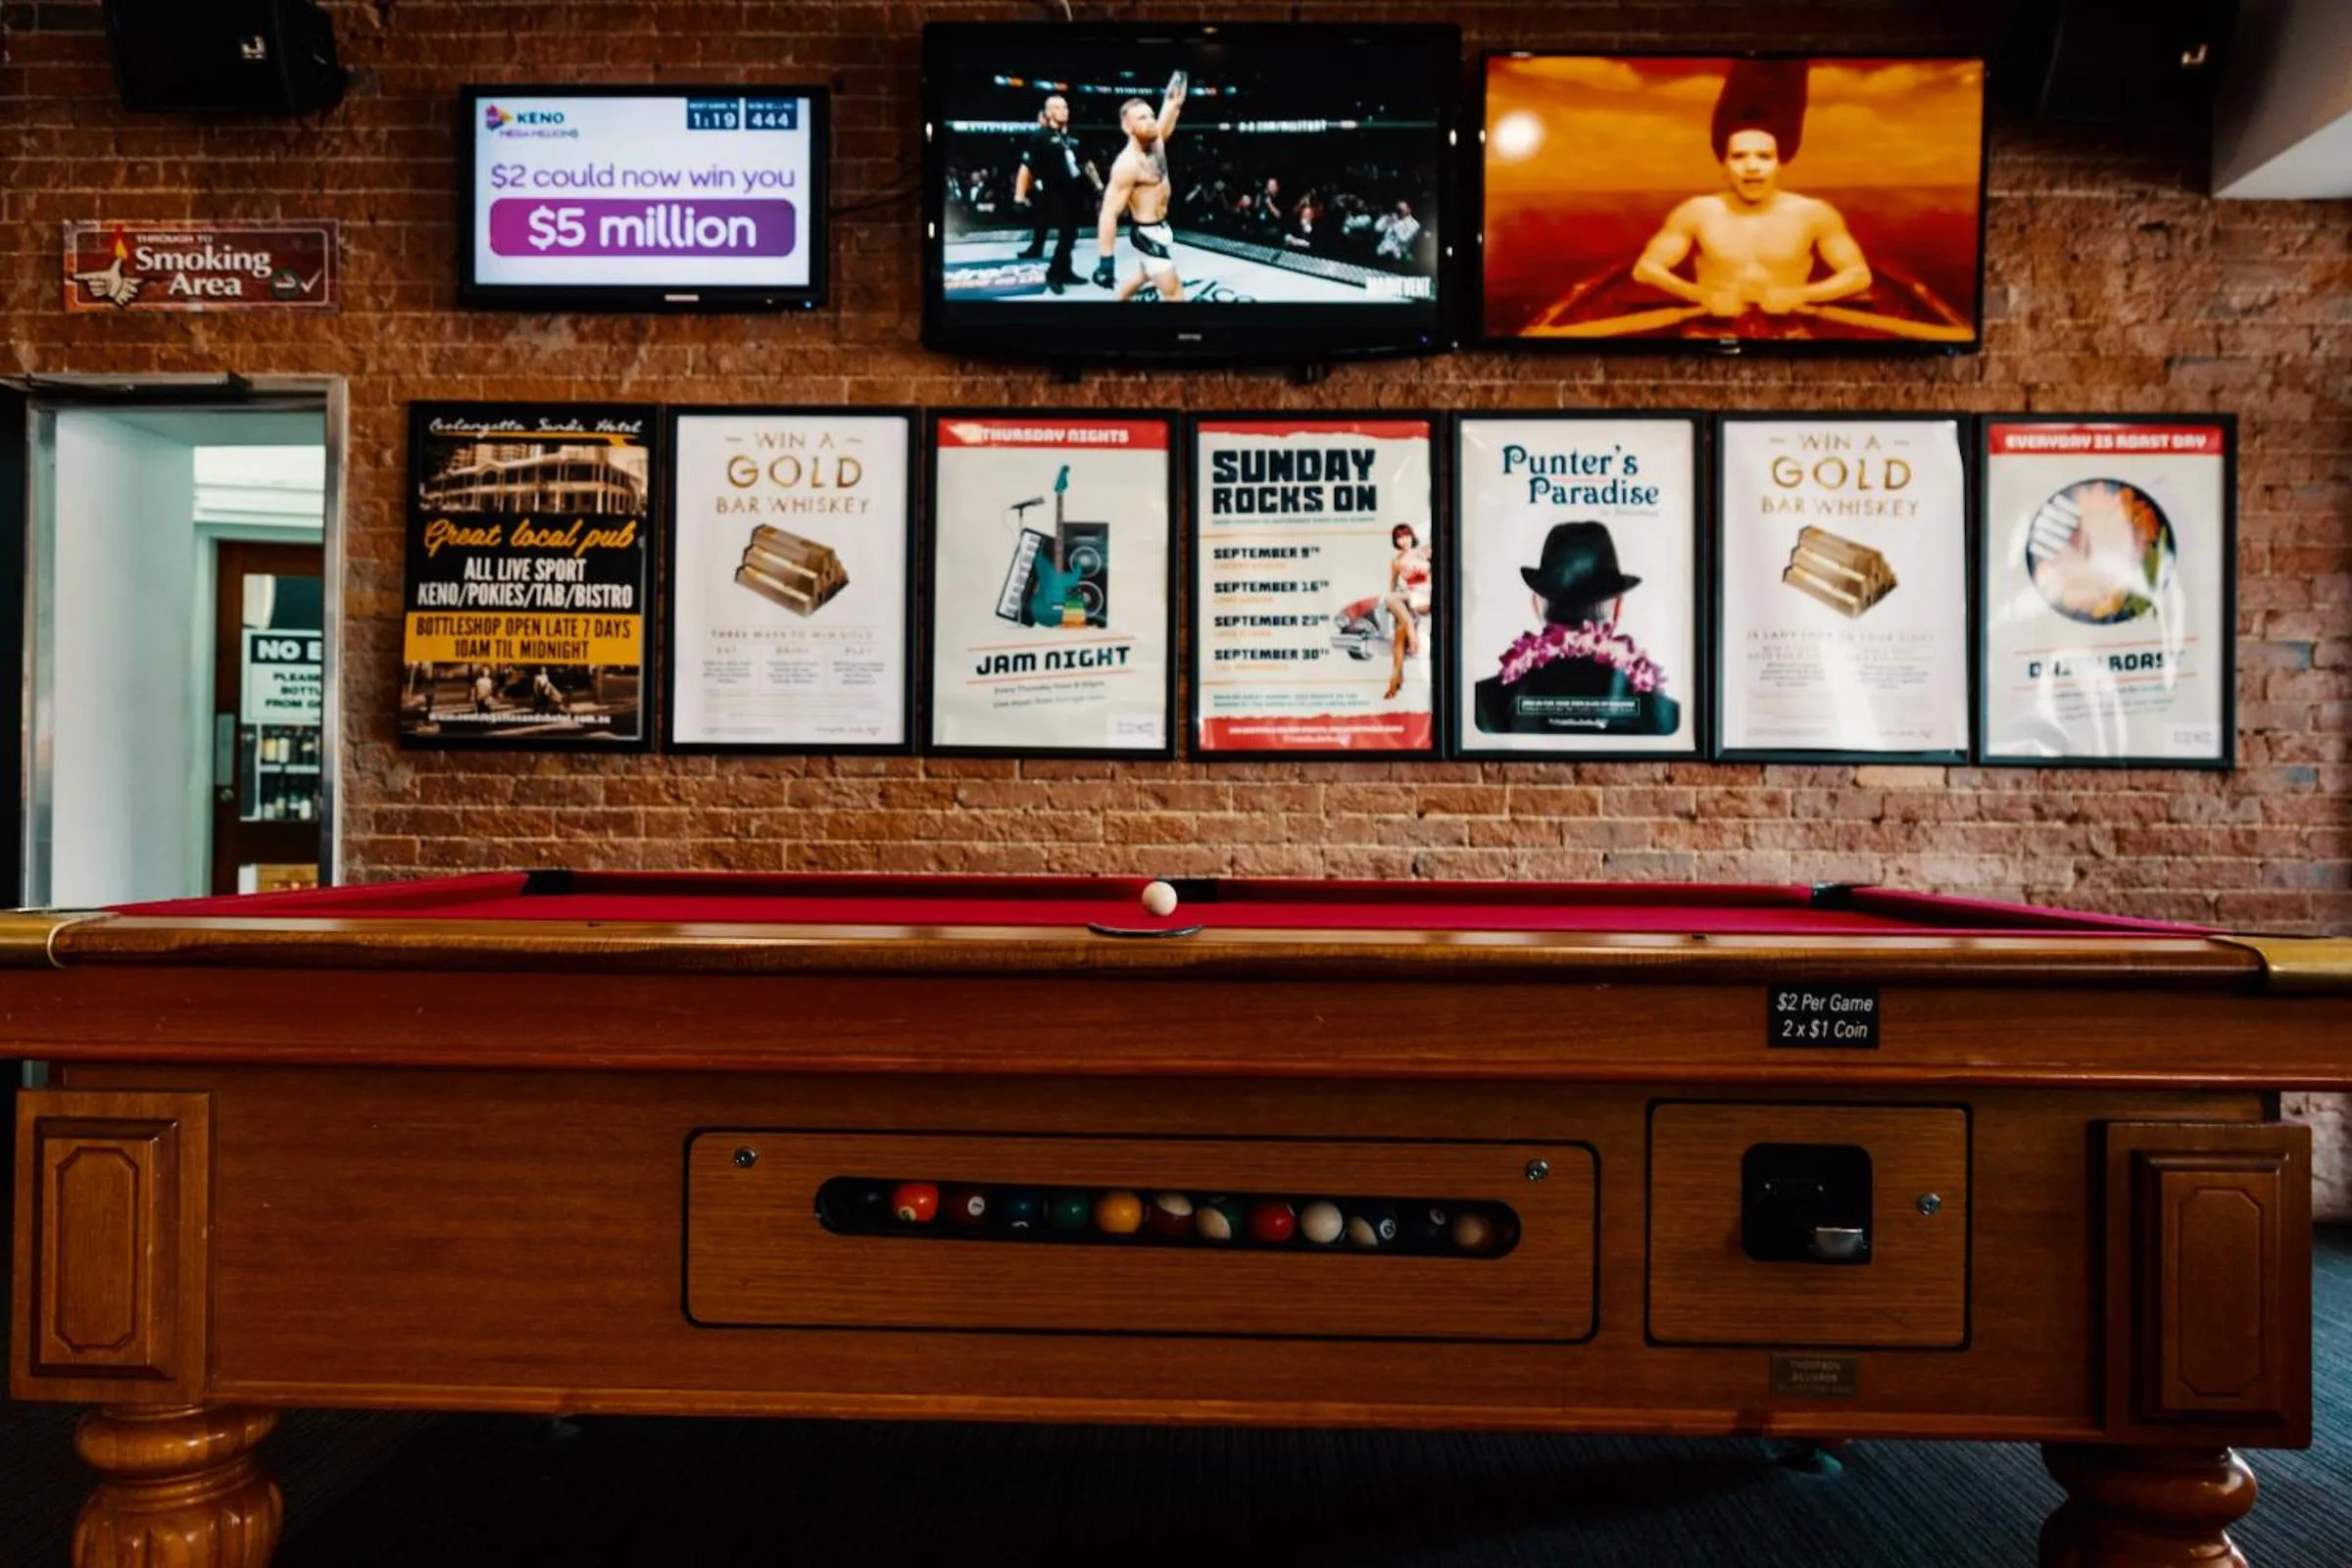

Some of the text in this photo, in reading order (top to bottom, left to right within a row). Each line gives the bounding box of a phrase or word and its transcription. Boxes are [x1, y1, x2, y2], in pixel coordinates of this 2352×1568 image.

[515, 112, 565, 125] KENO
[693, 112, 736, 127] 1:19
[751, 112, 790, 127] 444
[490, 163, 797, 194] $2 could now win you
[527, 204, 758, 251] $5 million
[136, 234, 214, 243] THROUGH TO
[135, 244, 273, 278] Smoking
[168, 271, 243, 296] Area
[429, 417, 643, 438] Coolangatta Sands Hotel
[982, 427, 1129, 444] THURSDAY NIGHTS
[755, 431, 835, 448] WIN A
[1798, 432, 1882, 451] WIN A
[2005, 433, 2208, 450] EVERYDAY IS ROAST DAY
[1212, 449, 1376, 483] SUNDAY
[1501, 444, 1640, 476] Punter's
[726, 455, 862, 488] GOLD
[1771, 457, 1912, 491] GOLD
[1212, 485, 1377, 514] ROCKS ON
[1529, 476, 1659, 506] Paradise
[715, 496, 870, 514] BAR WHISKEY
[1761, 497, 1919, 516] BAR WHISKEY
[423, 517, 637, 559] Great local pub
[1213, 547, 1298, 560] SEPTEMBER
[464, 557, 587, 582] ALL LIVE SPORT
[416, 582, 634, 609] KENO/POKIES/TAB/BISTRO
[1213, 581, 1298, 594] SEPTEMBER
[416, 616, 631, 639] BOTTLESHOP OPEN LATE 7 DAYS
[1213, 615, 1298, 627] SEPTEMBER
[257, 639, 301, 661] NO
[454, 638, 589, 660] 10AM TIL MIDNIGHT
[1213, 649, 1298, 661] SEPTEMBER
[976, 646, 1131, 675] JAM NIGHT
[265, 699, 303, 708] FROM
[1777, 992, 1874, 1012] $2 Per Game
[1782, 1018, 1868, 1039] 2 x $1 Coin
